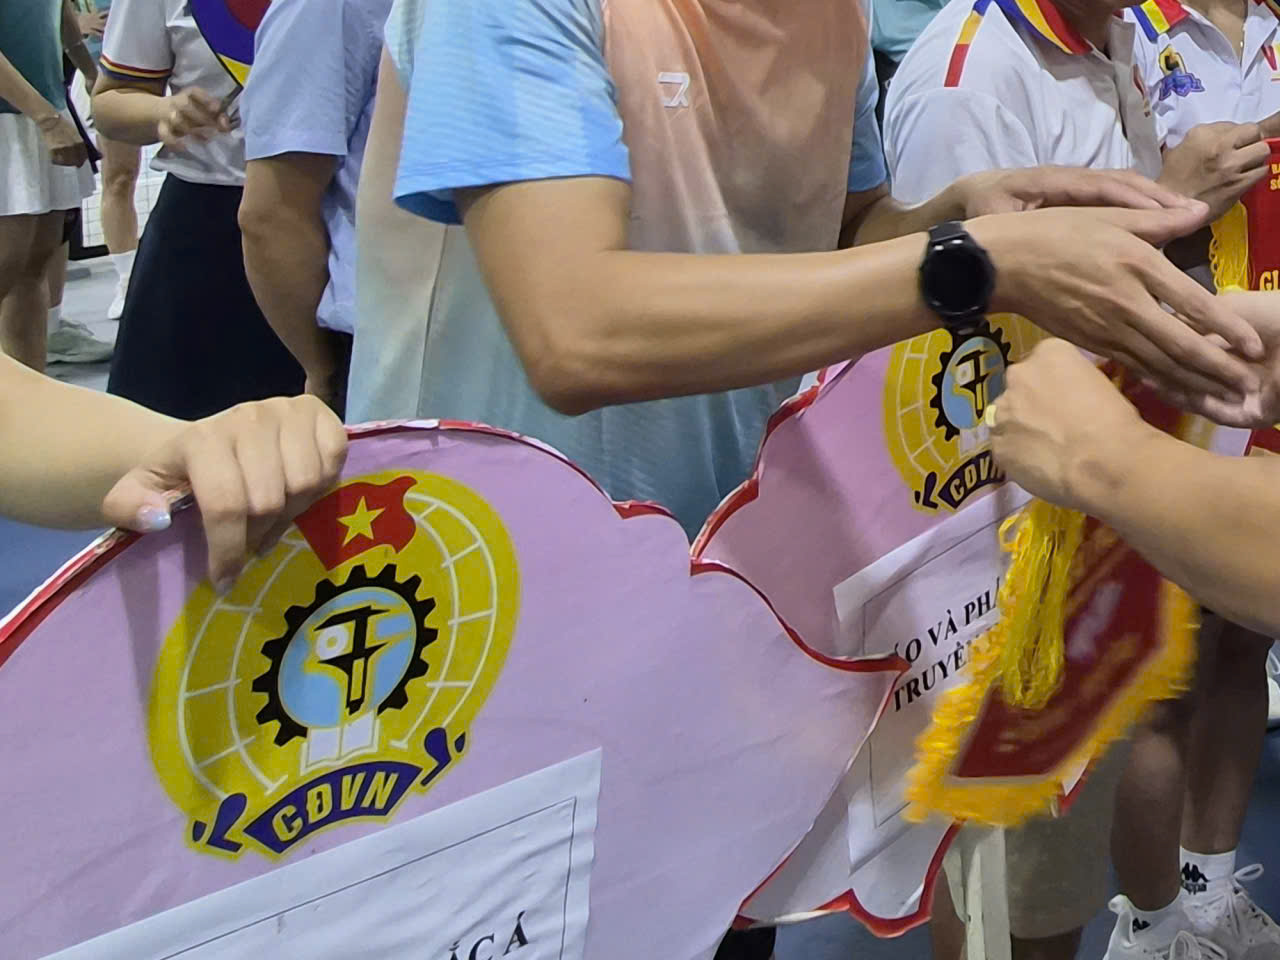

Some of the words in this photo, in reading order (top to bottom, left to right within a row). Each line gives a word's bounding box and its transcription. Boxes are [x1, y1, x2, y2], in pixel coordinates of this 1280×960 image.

[927, 609, 958, 646] VÀ
[894, 640, 970, 713] TRUYỀ
[272, 771, 399, 842] CĐVN
